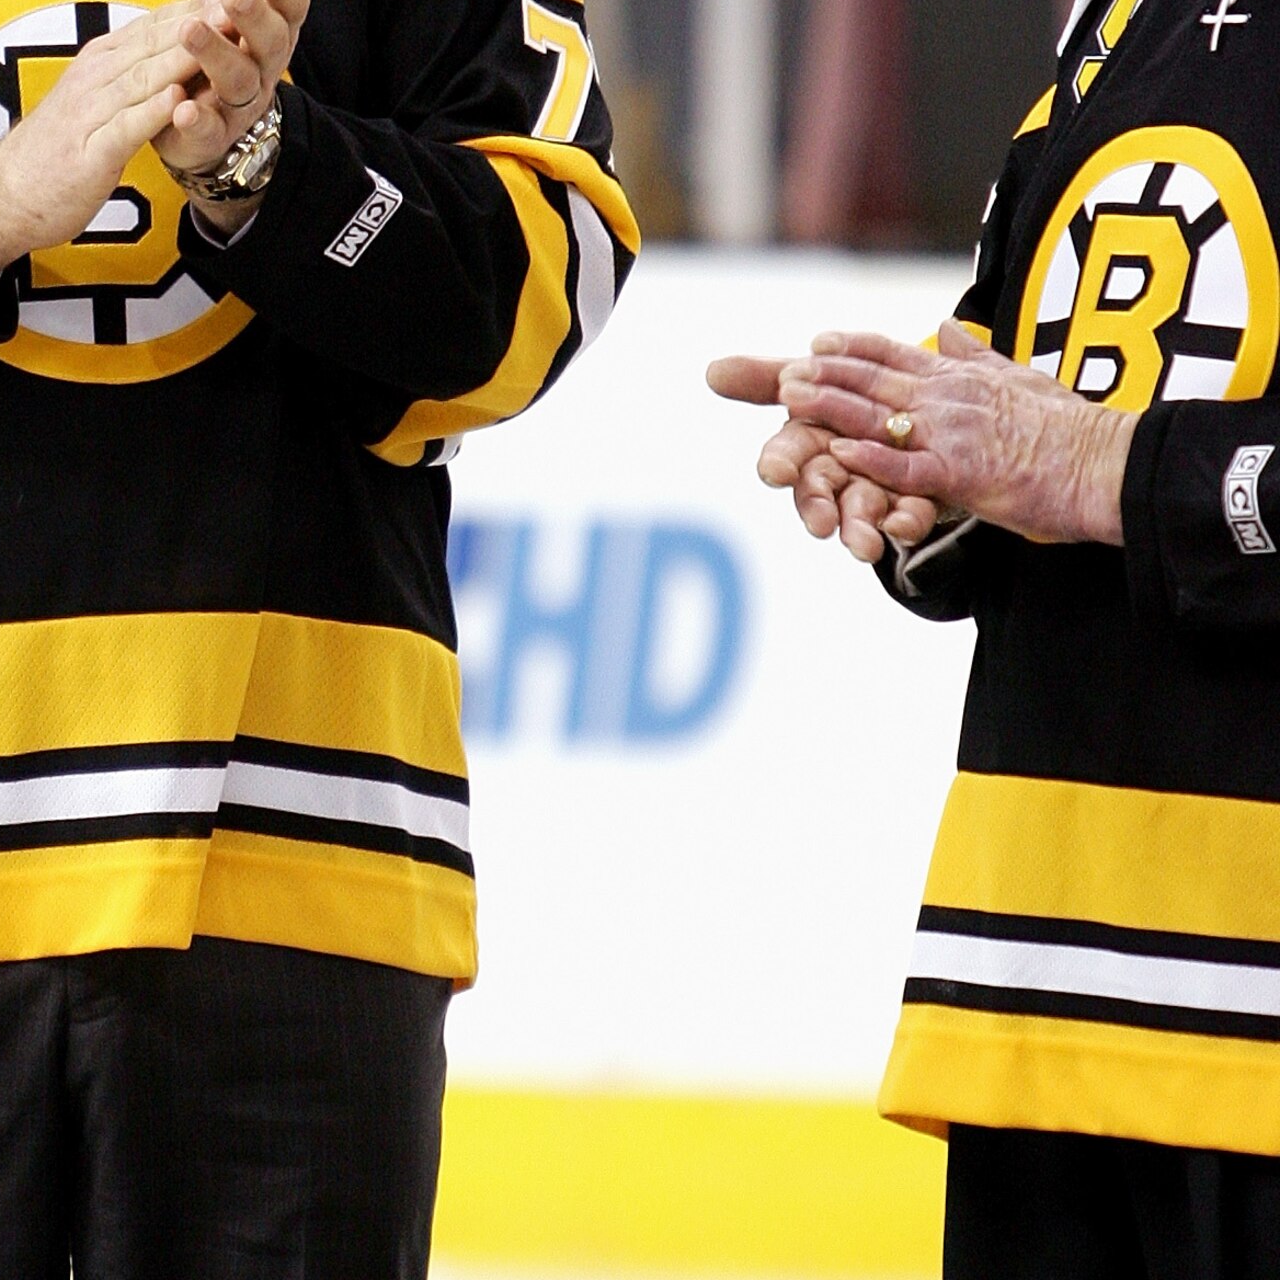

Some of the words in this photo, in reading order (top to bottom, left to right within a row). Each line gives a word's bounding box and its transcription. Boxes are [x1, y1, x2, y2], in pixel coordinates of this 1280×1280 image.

[331, 173, 398, 261] CM
[1058, 214, 1191, 414] B
[1228, 452, 1270, 551] CCM
